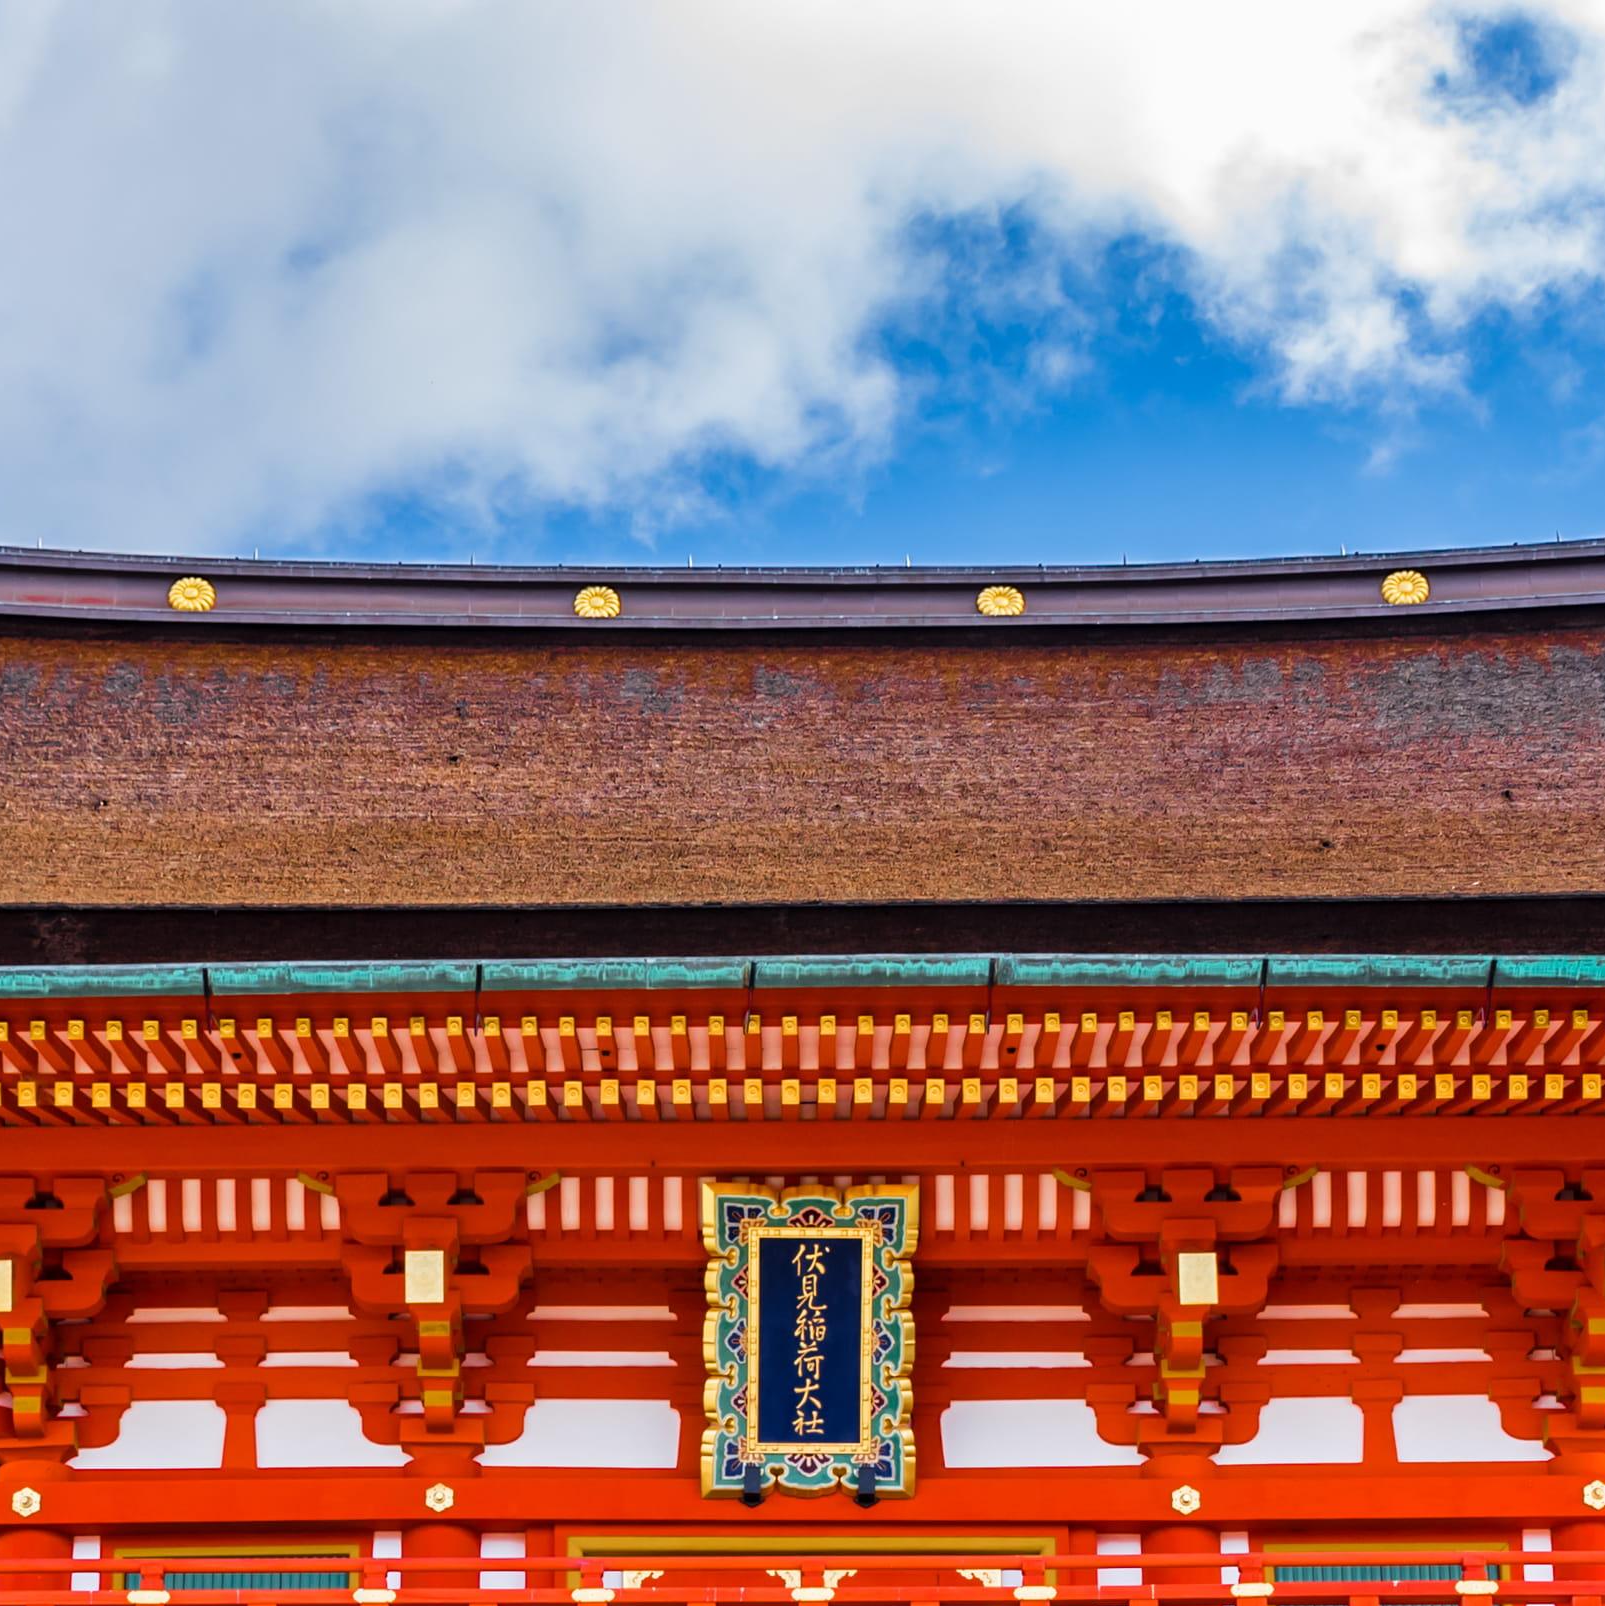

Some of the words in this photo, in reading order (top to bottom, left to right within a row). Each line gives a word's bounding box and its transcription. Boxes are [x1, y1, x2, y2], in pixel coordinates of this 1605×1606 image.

[792, 1243, 831, 1436] 伏見稲荷大社
